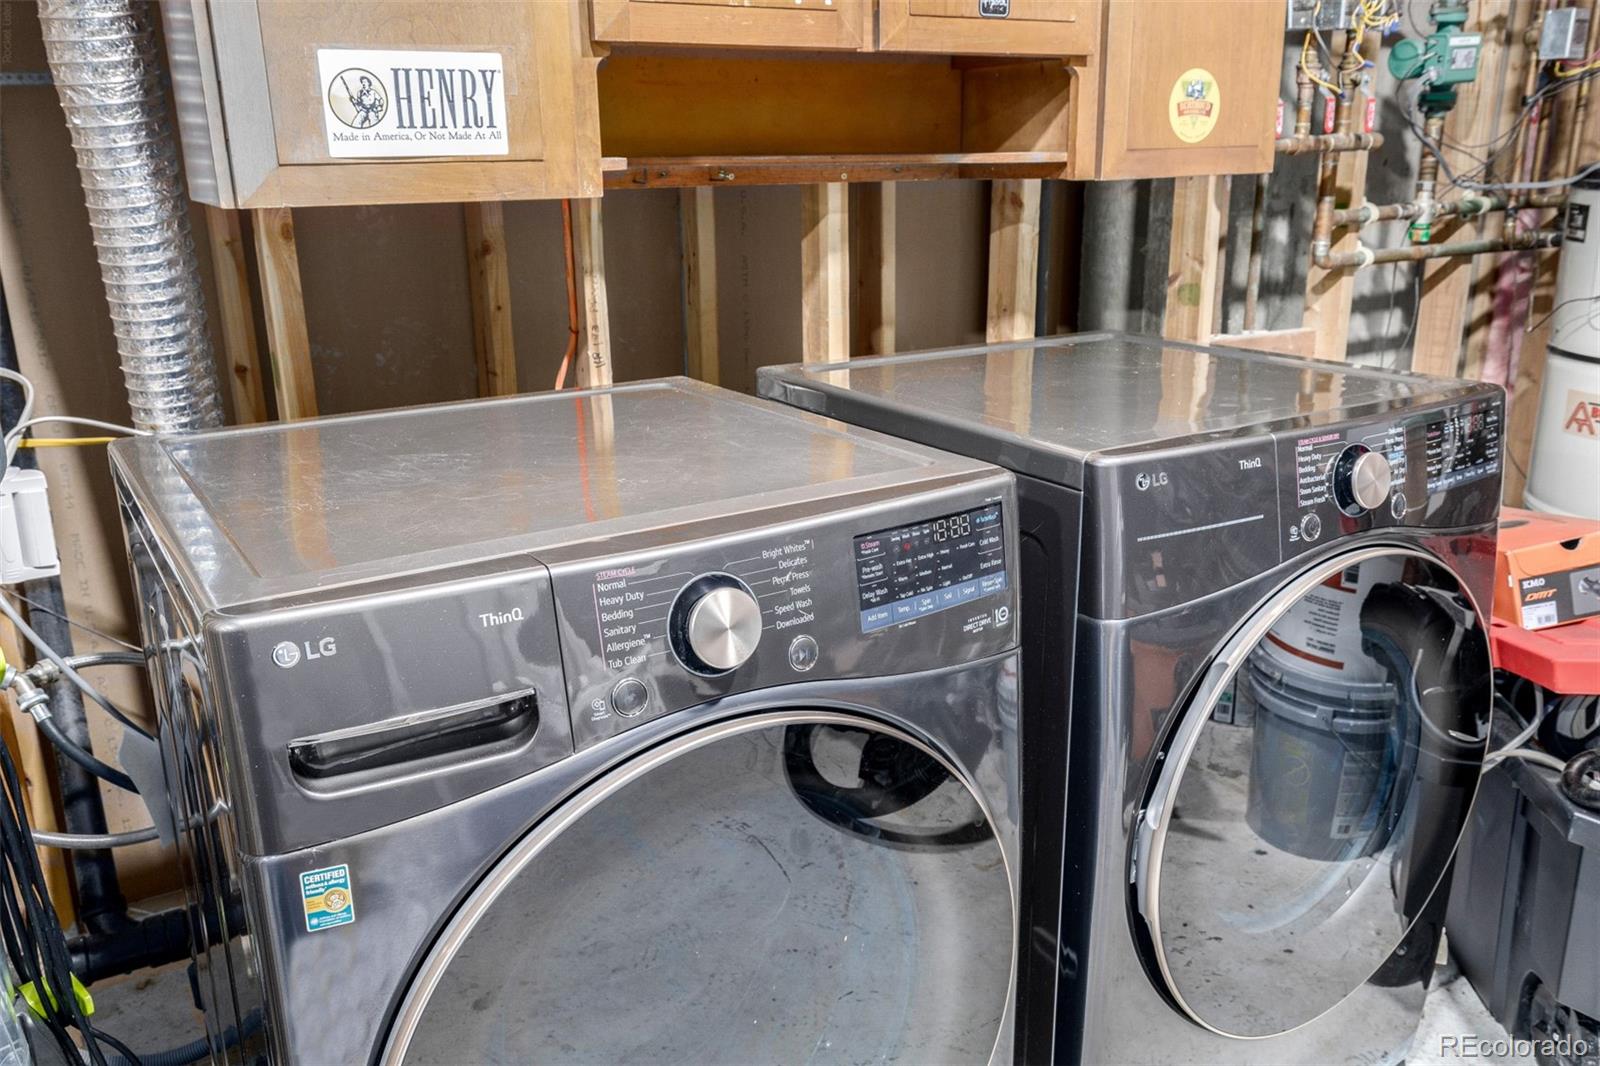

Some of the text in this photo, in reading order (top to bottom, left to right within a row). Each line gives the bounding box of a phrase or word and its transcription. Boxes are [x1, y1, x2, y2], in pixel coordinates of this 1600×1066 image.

[390, 67, 499, 129] HENRY
[333, 131, 502, 142] Made in America, Or Not Made At All
[1152, 457, 1262, 487] LG ThinQ
[762, 549, 782, 560] Bright
[778, 556, 807, 569] Delicates
[862, 563, 883, 573] Pre-wash
[791, 570, 810, 580] Press
[597, 578, 627, 592] Normal
[789, 584, 811, 596] Towels
[599, 591, 644, 607] Heavy Duty
[862, 591, 875, 600] Delay
[876, 588, 888, 596] Wash
[774, 598, 813, 615] Speed Wash
[601, 609, 634, 622] Bedding
[776, 612, 815, 630] Downloaded
[304, 607, 524, 660] LG ThinQ
[603, 625, 637, 638] Sanitary
[608, 654, 647, 669] Tub Clean
[304, 869, 346, 885] CERTIFIED
